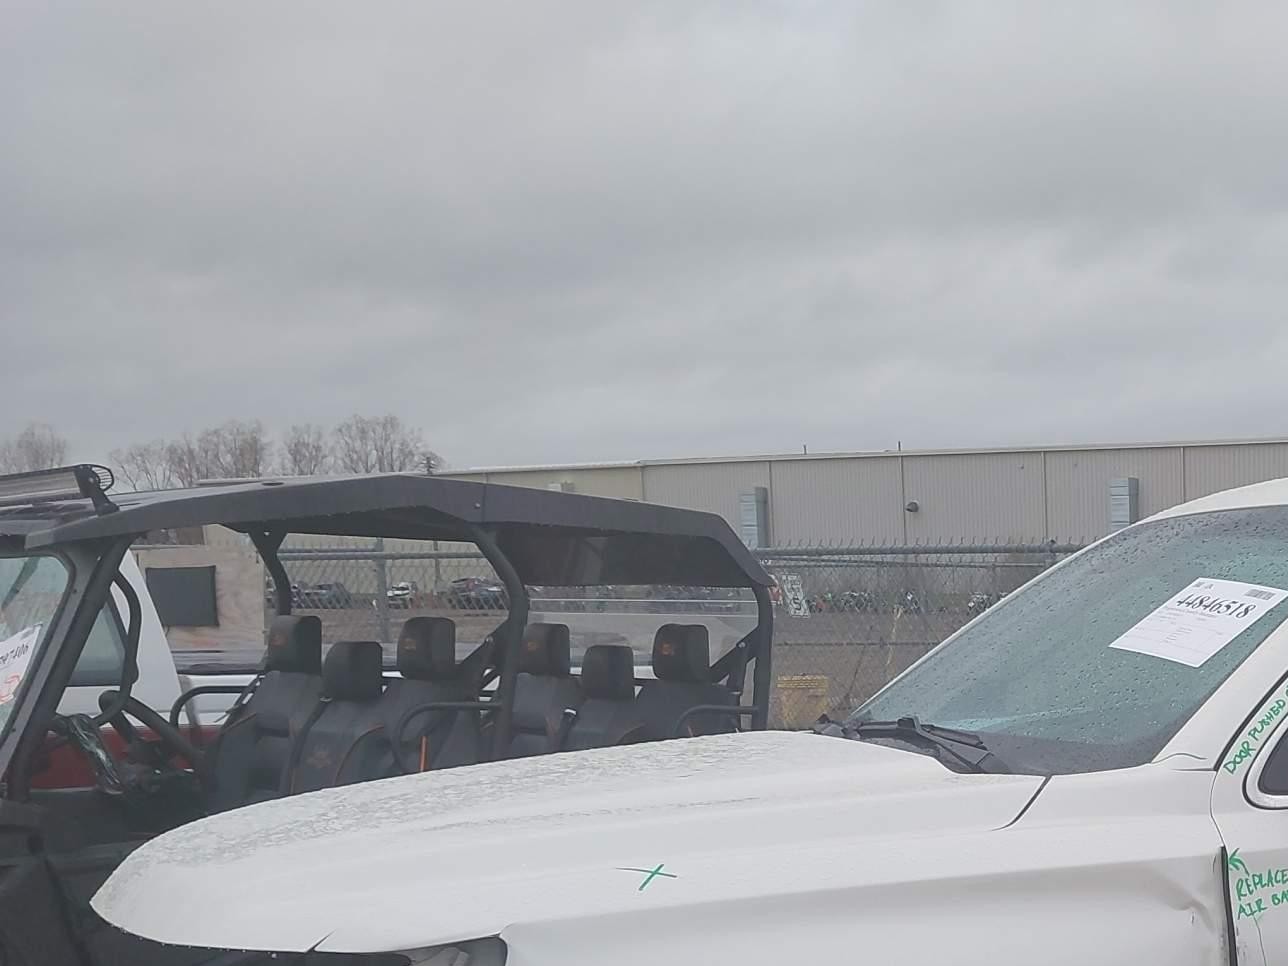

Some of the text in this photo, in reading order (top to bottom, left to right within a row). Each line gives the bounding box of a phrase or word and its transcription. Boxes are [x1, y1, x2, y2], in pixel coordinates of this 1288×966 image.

[1177, 593, 1257, 619] 44846518
[1223, 740, 1256, 775] DOOR
[1248, 699, 1286, 741] PUSHED
[1237, 898, 1268, 920] AIR
